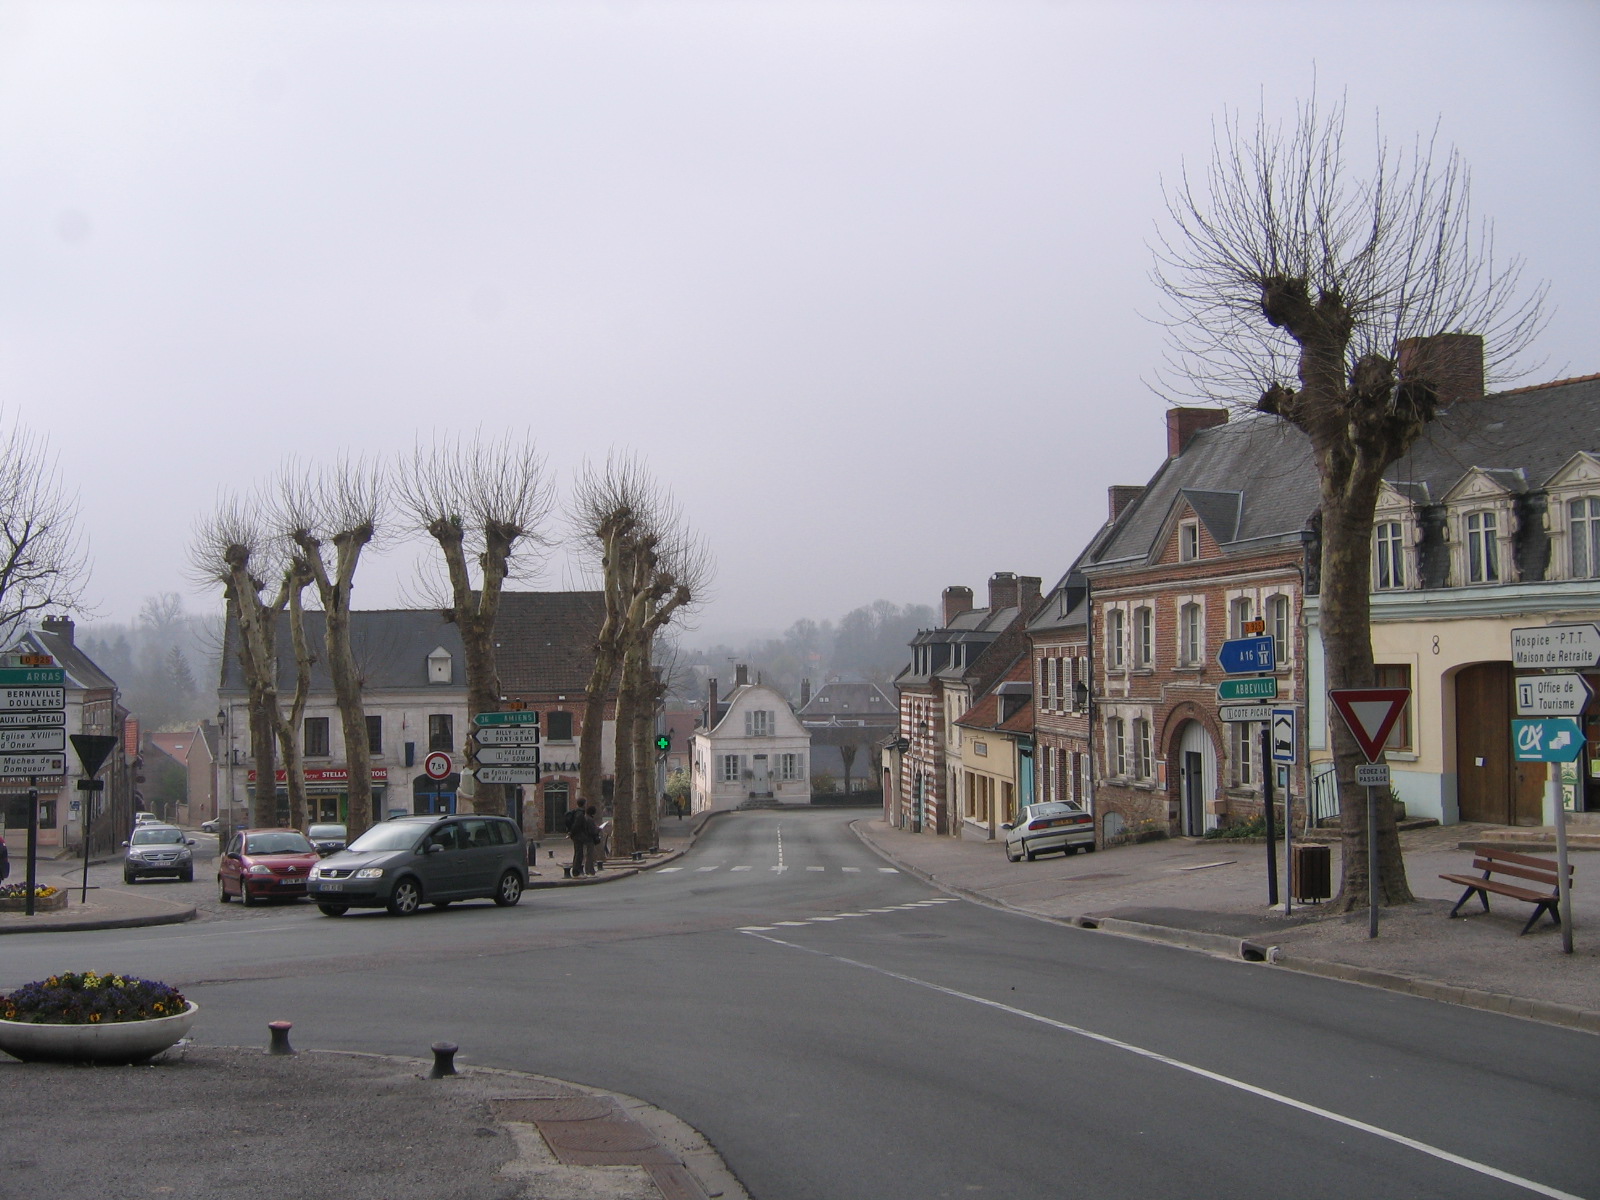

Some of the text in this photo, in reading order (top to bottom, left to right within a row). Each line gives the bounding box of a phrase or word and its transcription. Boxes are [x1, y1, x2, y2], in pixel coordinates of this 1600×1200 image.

[1432, 635, 1440, 655] 8
[1515, 634, 1550, 648] Hospice
[1240, 650, 1253, 661] A 16
[1516, 649, 1593, 663] Maison de Retraite
[26, 672, 61, 681] ARRAS
[1235, 682, 1273, 694] ABBEVILLE
[1538, 681, 1573, 693] Office de
[7, 690, 61, 698] BERNAVILLE
[9, 699, 61, 707] DOULLENS
[1539, 698, 1575, 709] Tourisme
[26, 714, 62, 723] CHÂTEAU
[504, 714, 532, 722] AMIENS
[1, 732, 25, 741] Église
[3, 757, 35, 765] Muches
[3, 765, 46, 773] Domqueur
[431, 762, 445, 770] 7,5t
